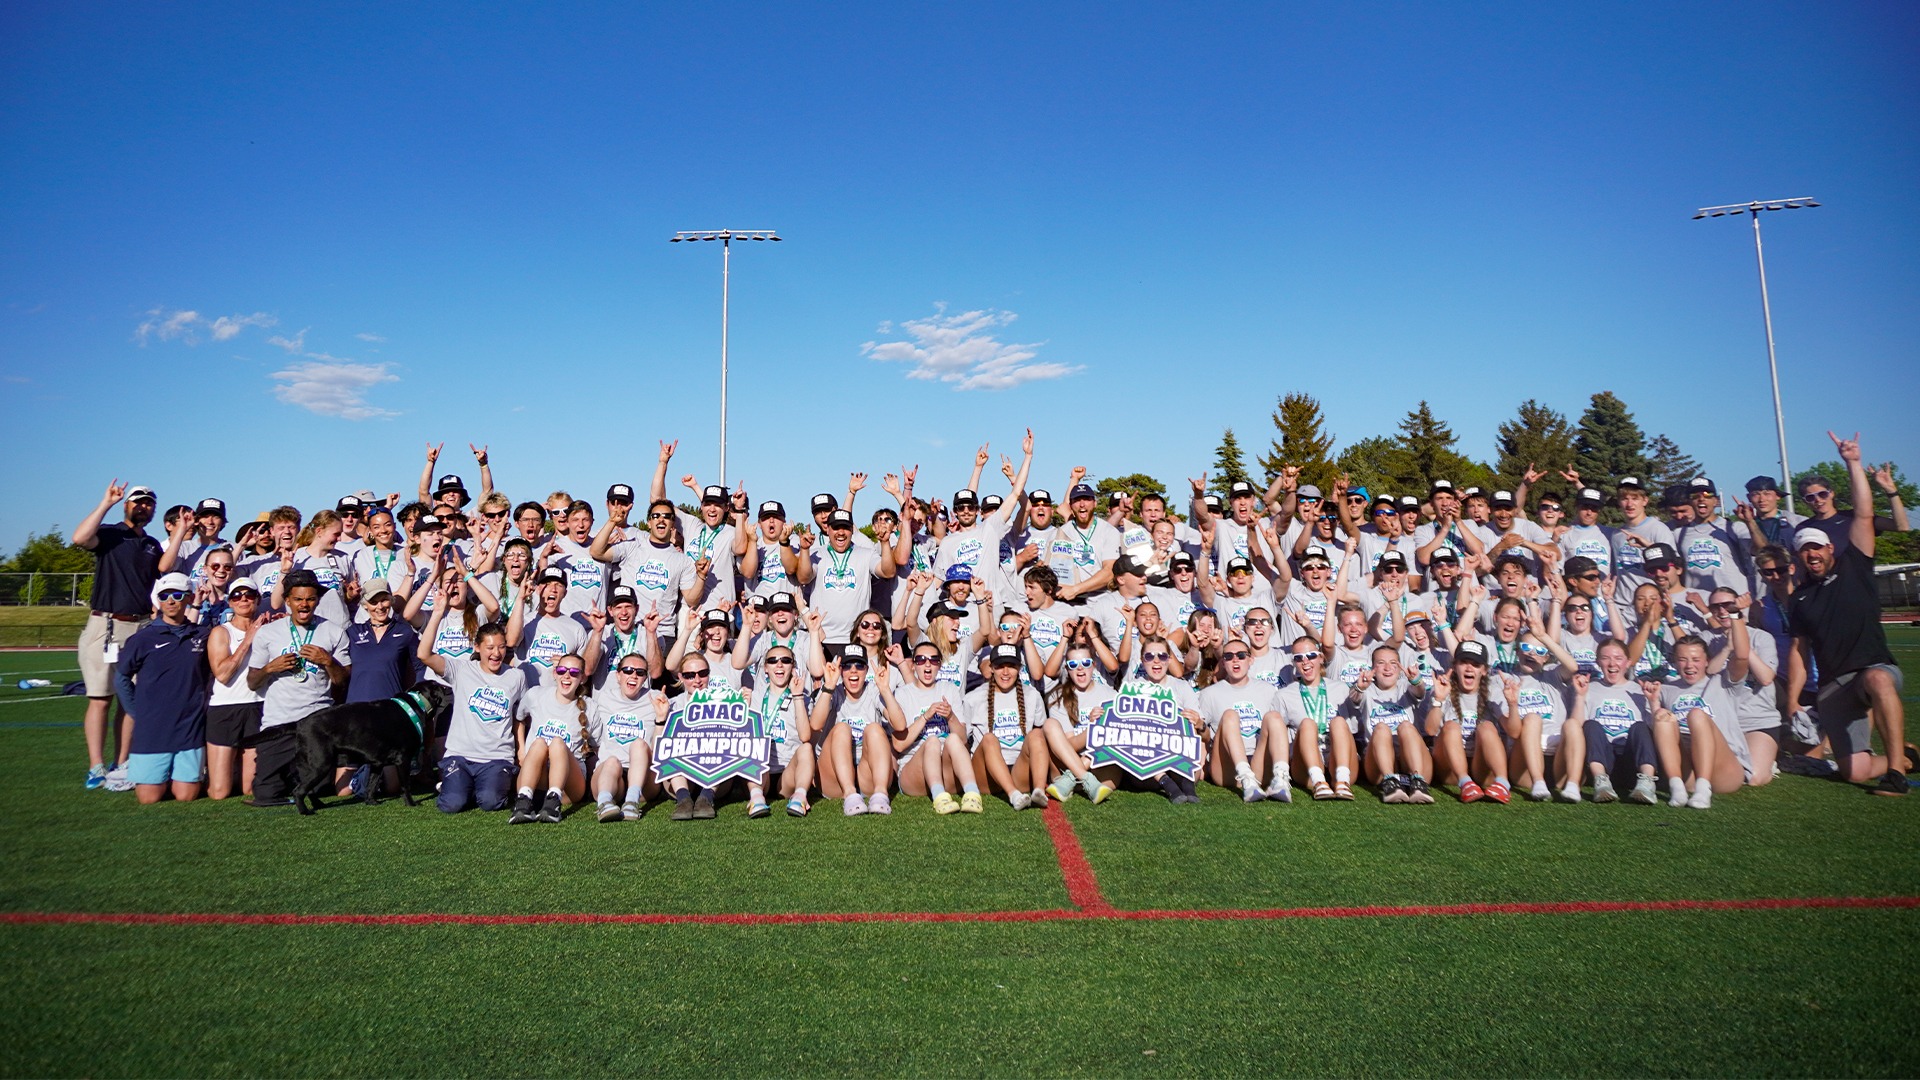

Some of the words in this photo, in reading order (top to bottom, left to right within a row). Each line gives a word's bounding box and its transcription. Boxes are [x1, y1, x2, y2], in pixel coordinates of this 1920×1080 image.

[1125, 534, 1146, 547] GNAC
[1052, 545, 1072, 554] GNAC
[577, 563, 595, 571] GNAC
[437, 640, 470, 649] CHAMPIO
[540, 638, 560, 646] GNAC
[483, 687, 504, 701] GNAC
[1519, 695, 1542, 703] GNAC
[1118, 696, 1174, 719] GNAC
[1602, 704, 1626, 714] GNAC
[687, 704, 744, 722] GNAC
[997, 715, 1018, 723] GNAC
[1109, 721, 1136, 730] OUTDOOR
[544, 725, 566, 738] GNAC
[1091, 725, 1197, 760] CHAMPION
[658, 738, 766, 761] CHAMPION
